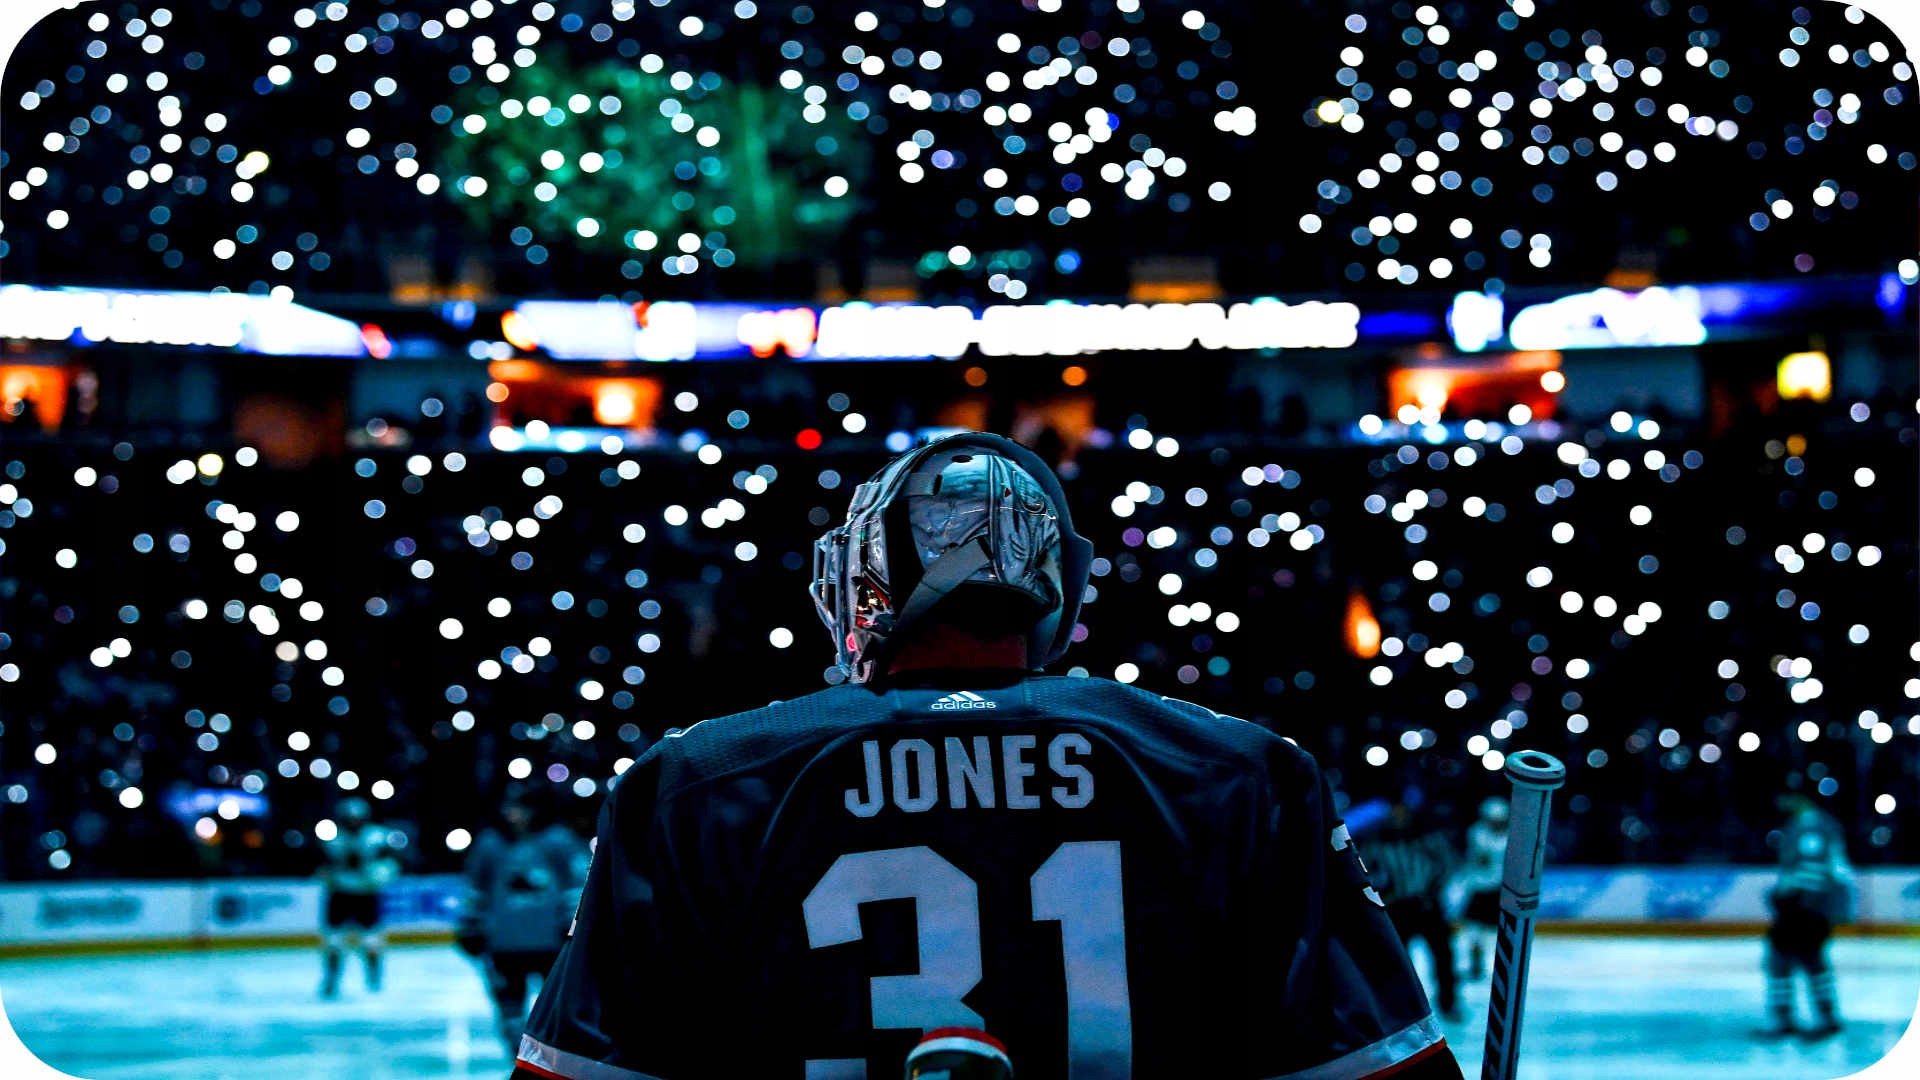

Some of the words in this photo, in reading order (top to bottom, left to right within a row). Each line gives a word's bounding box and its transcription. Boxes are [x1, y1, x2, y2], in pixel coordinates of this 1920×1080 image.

[931, 700, 997, 710] adidas
[845, 733, 1095, 818] JONES
[802, 840, 1133, 1080] 31
